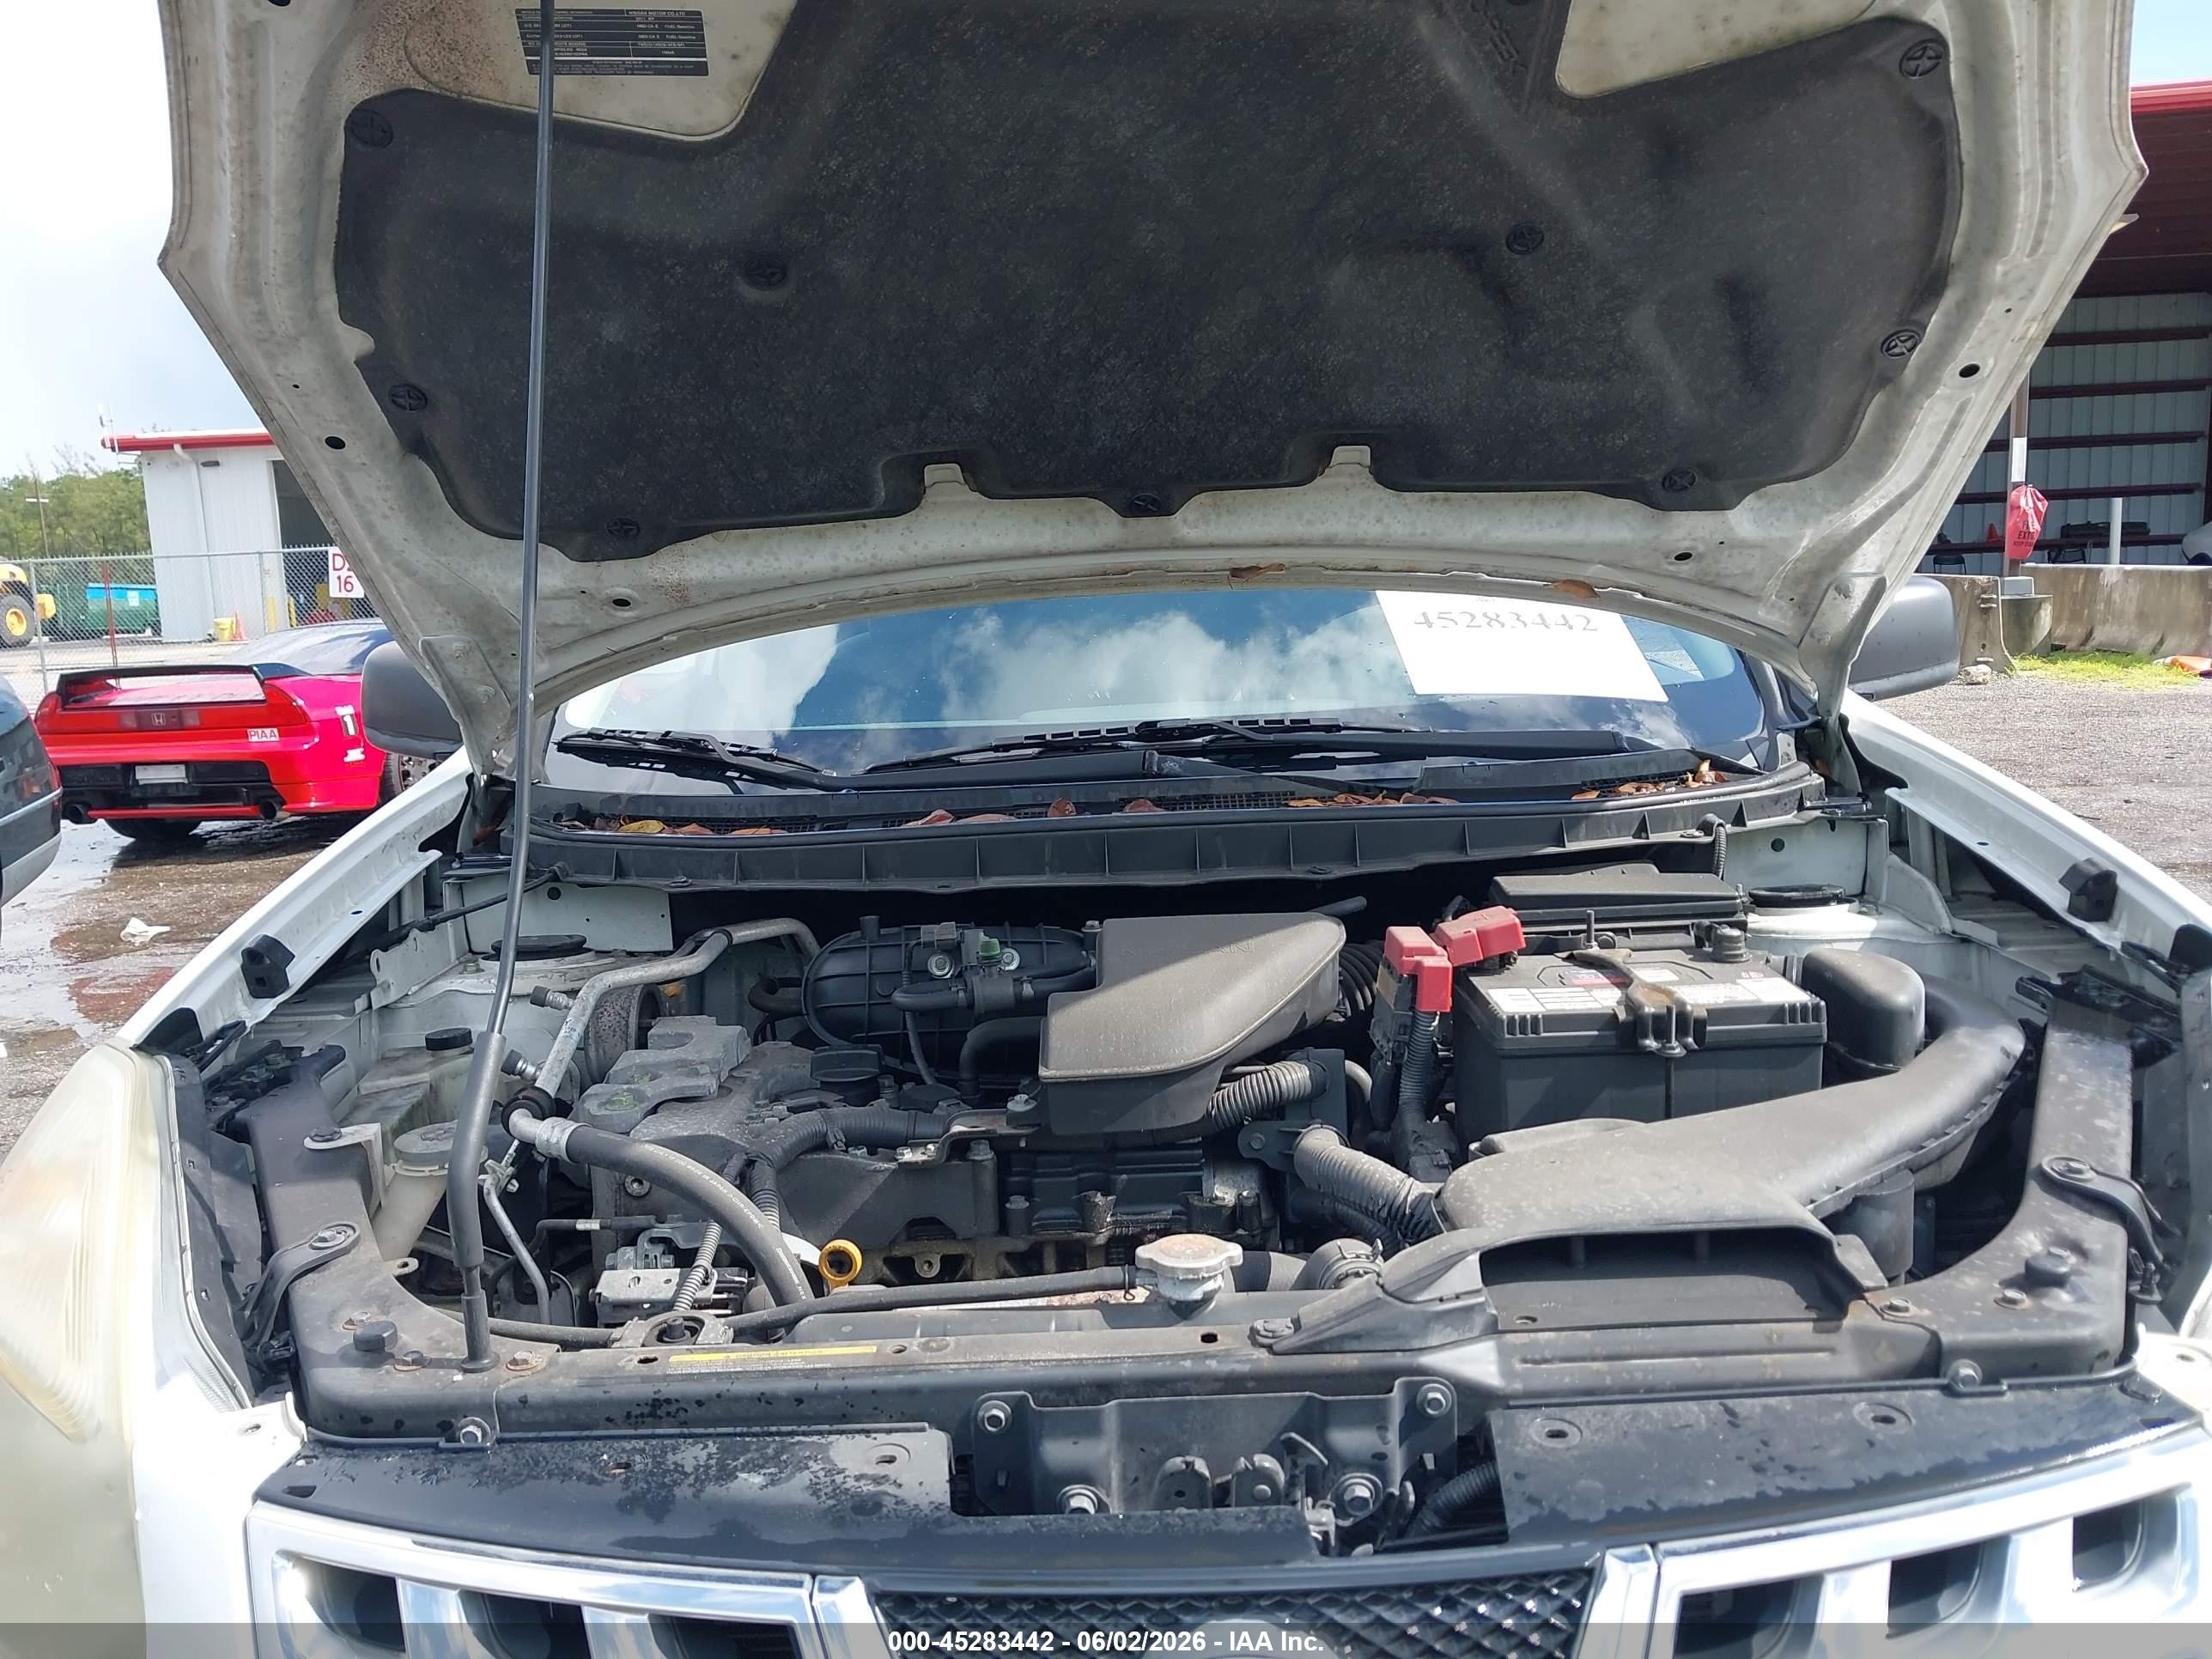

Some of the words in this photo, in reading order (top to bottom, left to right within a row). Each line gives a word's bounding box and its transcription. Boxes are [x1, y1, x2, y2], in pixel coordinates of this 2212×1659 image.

[332, 553, 353, 572] D
[337, 574, 354, 592] 16
[1413, 611, 1599, 632] 45283442
[248, 728, 278, 741] PIAA
